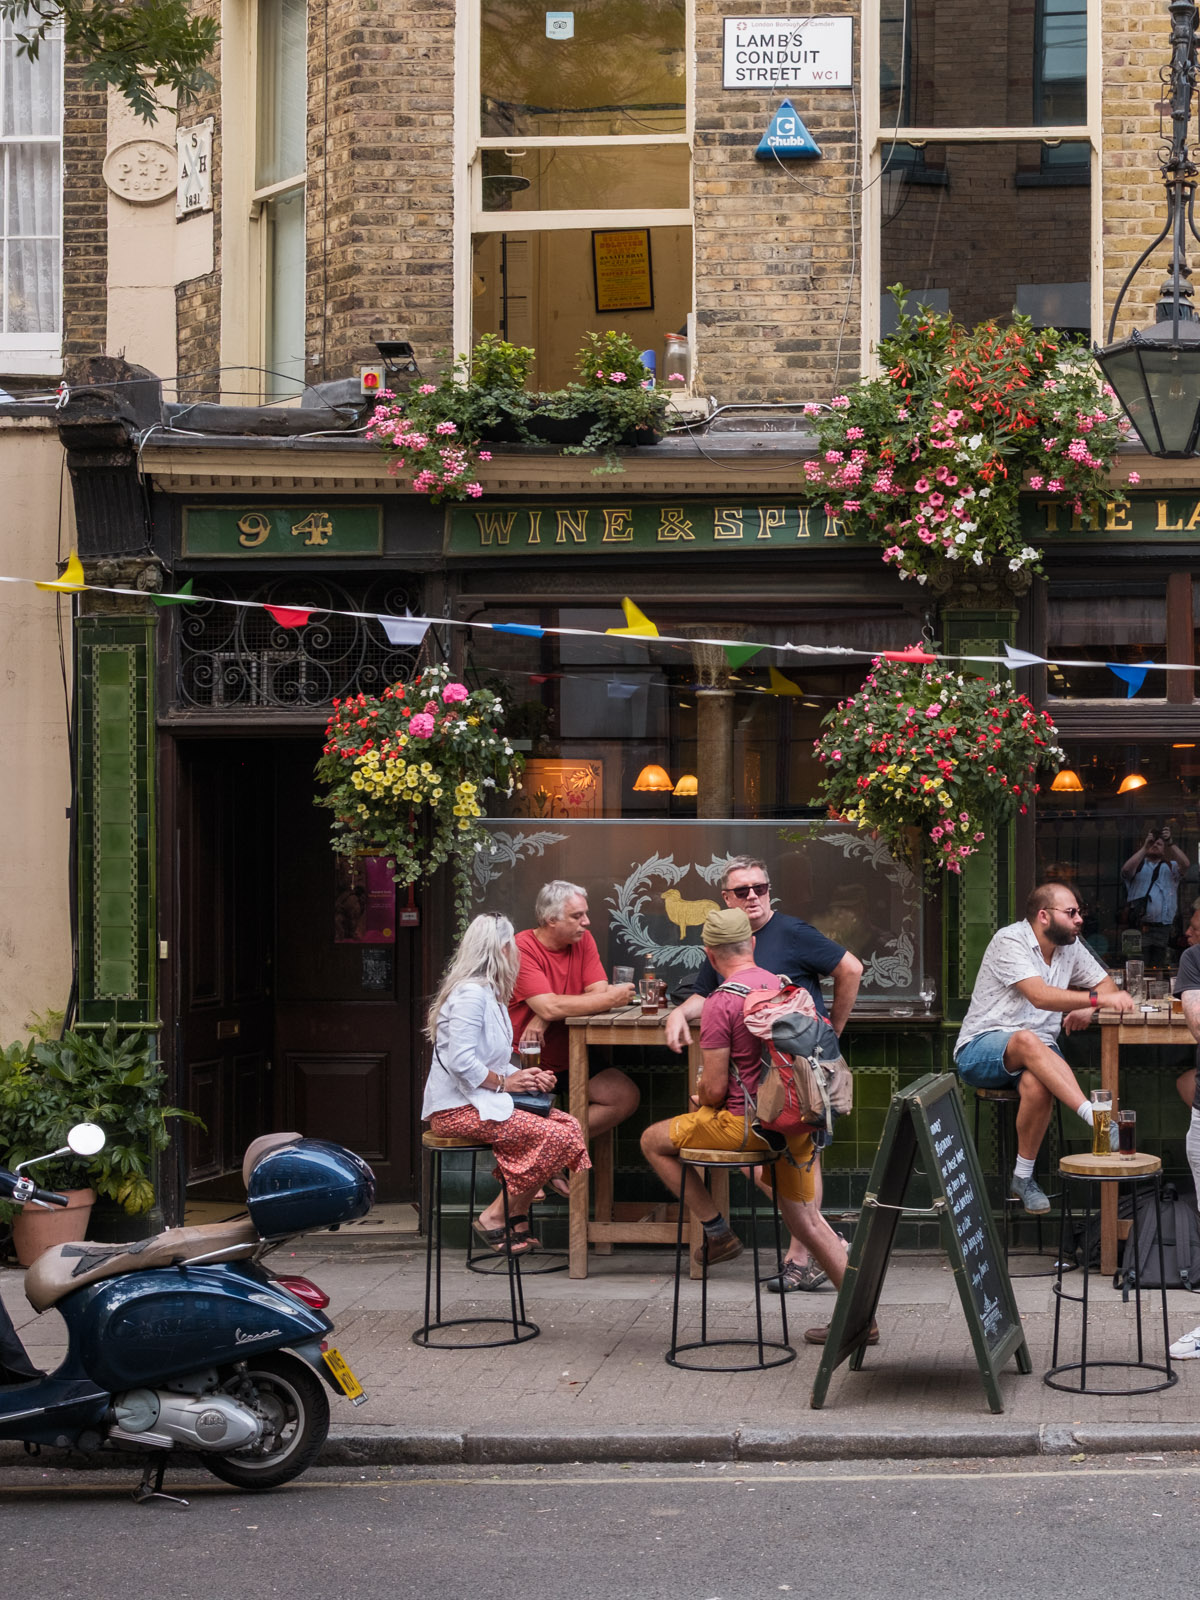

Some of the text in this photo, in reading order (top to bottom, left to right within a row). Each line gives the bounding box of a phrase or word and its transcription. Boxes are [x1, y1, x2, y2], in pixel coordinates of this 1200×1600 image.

[736, 32, 803, 48] LAMB'S
[736, 51, 820, 64] CONDUIT
[736, 67, 838, 81] STREET WC1
[191, 133, 198, 148] S
[767, 136, 805, 146] Chubb
[475, 509, 633, 545] WINE
[657, 508, 696, 541] &
